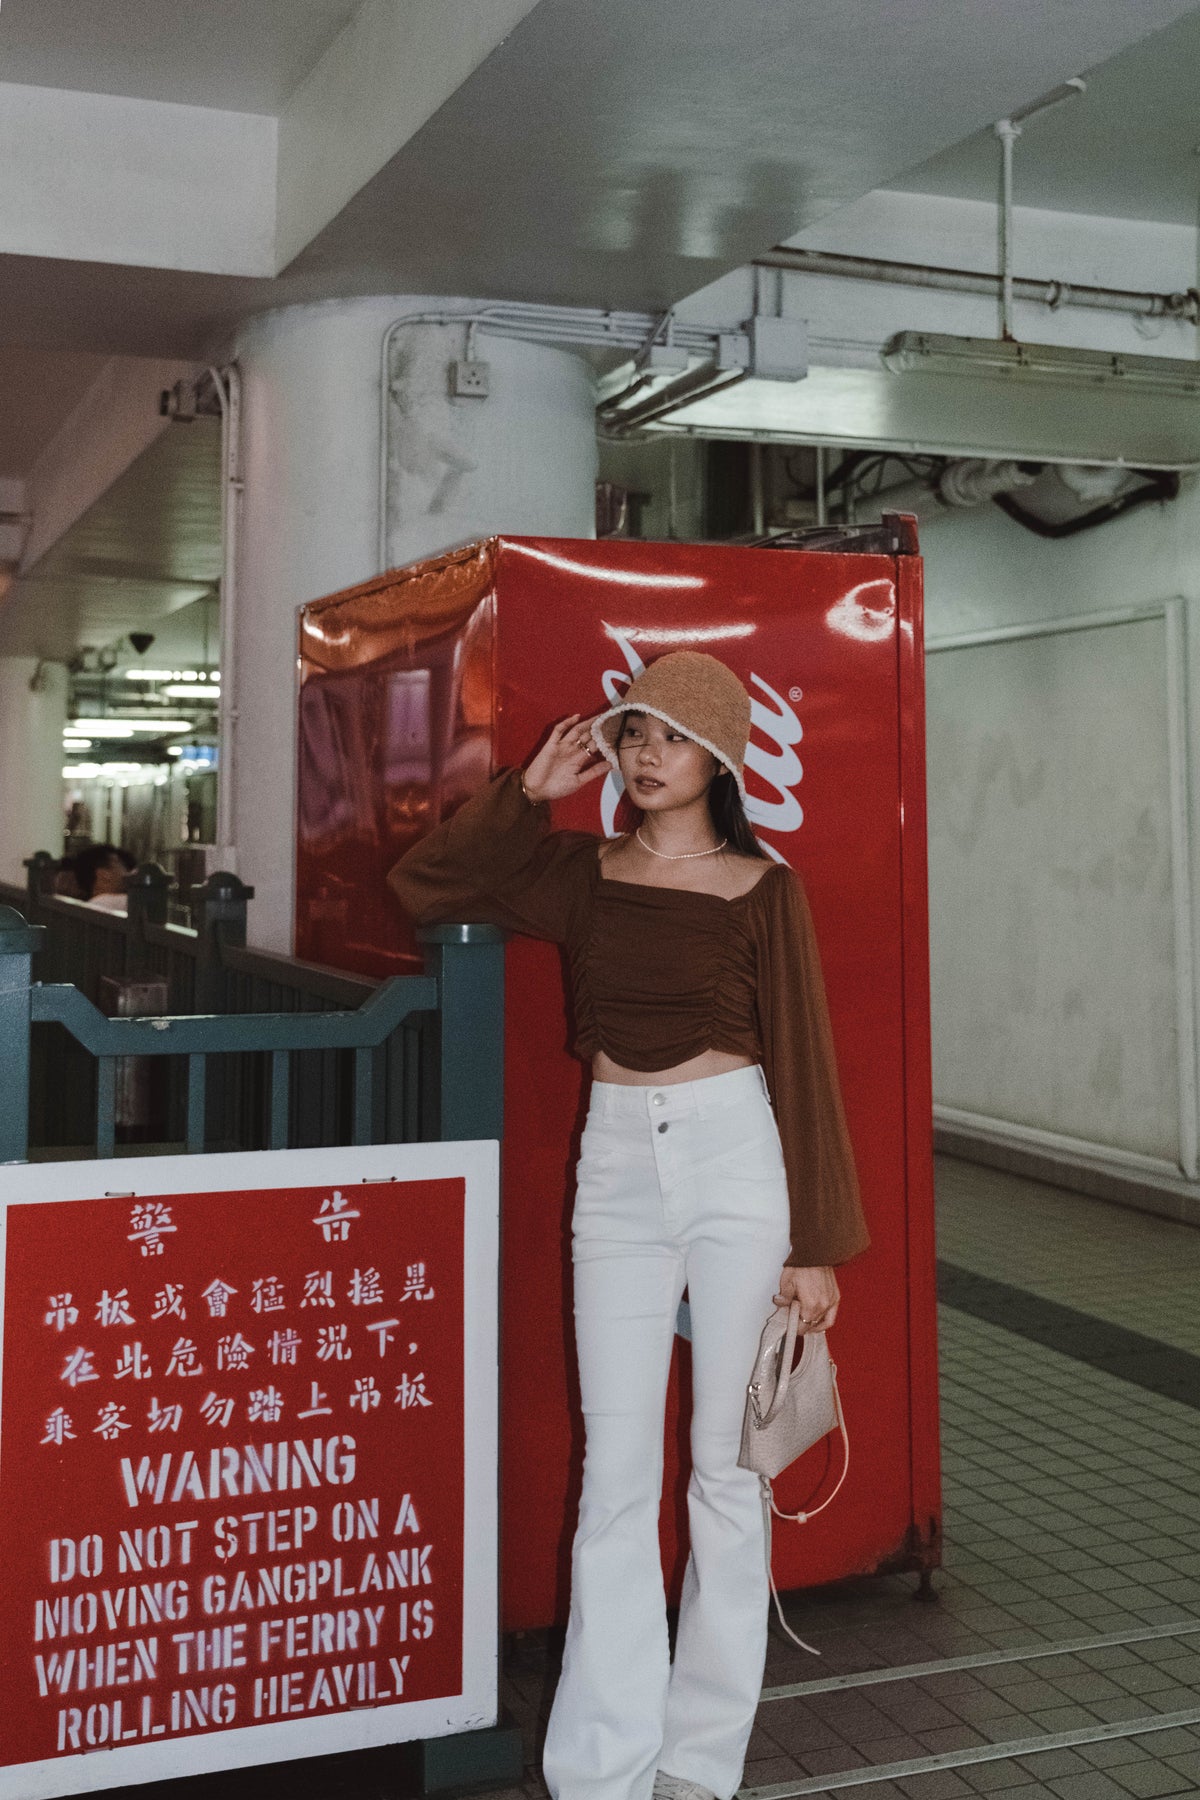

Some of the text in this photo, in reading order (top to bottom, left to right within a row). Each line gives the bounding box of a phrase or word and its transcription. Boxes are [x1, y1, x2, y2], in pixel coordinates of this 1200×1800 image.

[39, 1374, 434, 1445] 乘客切勿踏上吊板
[120, 1435, 357, 1507] WARNING
[49, 1493, 420, 1583] DO NOT STEP ON A
[34, 1545, 434, 1642] MOVING GANGPLANK
[34, 1600, 434, 1697] WHEN THE FERRY IS
[57, 1656, 411, 1751] ROLLING HEAVILY
